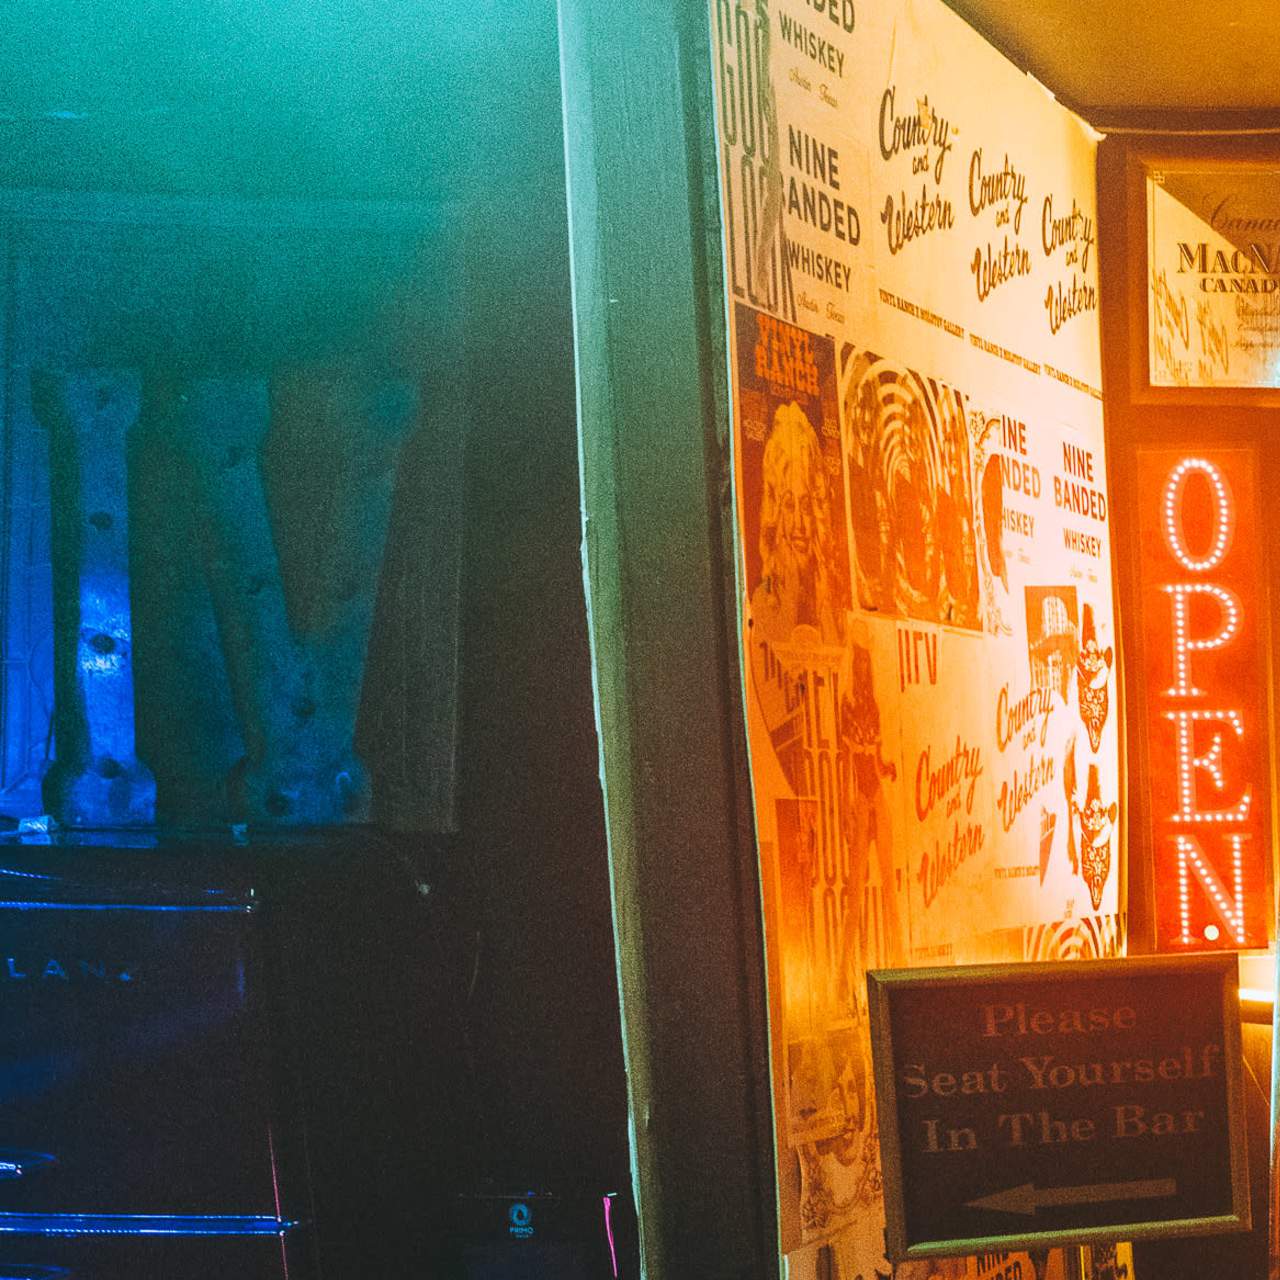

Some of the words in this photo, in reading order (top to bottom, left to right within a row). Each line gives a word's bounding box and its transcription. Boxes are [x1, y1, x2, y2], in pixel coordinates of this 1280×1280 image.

[779, 10, 845, 78] WHISKEY
[788, 124, 840, 191] NINE
[879, 85, 952, 185] Country
[912, 149, 930, 175] and
[881, 184, 955, 256] Western
[969, 147, 1028, 235] Country
[996, 204, 1010, 228] and
[786, 240, 851, 293] WHISKEY
[971, 235, 1032, 303] Western
[1045, 273, 1097, 335] Western
[1002, 414, 1028, 456] INE
[1062, 441, 1094, 483] NINE
[1001, 453, 1041, 499] NDED
[1054, 475, 1107, 522] BANDED
[1001, 508, 1036, 538] HISKEY
[1062, 527, 1102, 560] WHISKEY
[996, 682, 1055, 754] Country
[1161, 456, 1252, 945] OPEN
[915, 735, 984, 822] Country
[997, 752, 1055, 833] Western
[917, 819, 985, 909] Western
[980, 1001, 1138, 1039] Please
[902, 1062, 1009, 1100] Seat
[1018, 1044, 1221, 1090] Yourself
[921, 1118, 978, 1153] In
[999, 1110, 1097, 1148] The
[1111, 1103, 1206, 1139] Bar
